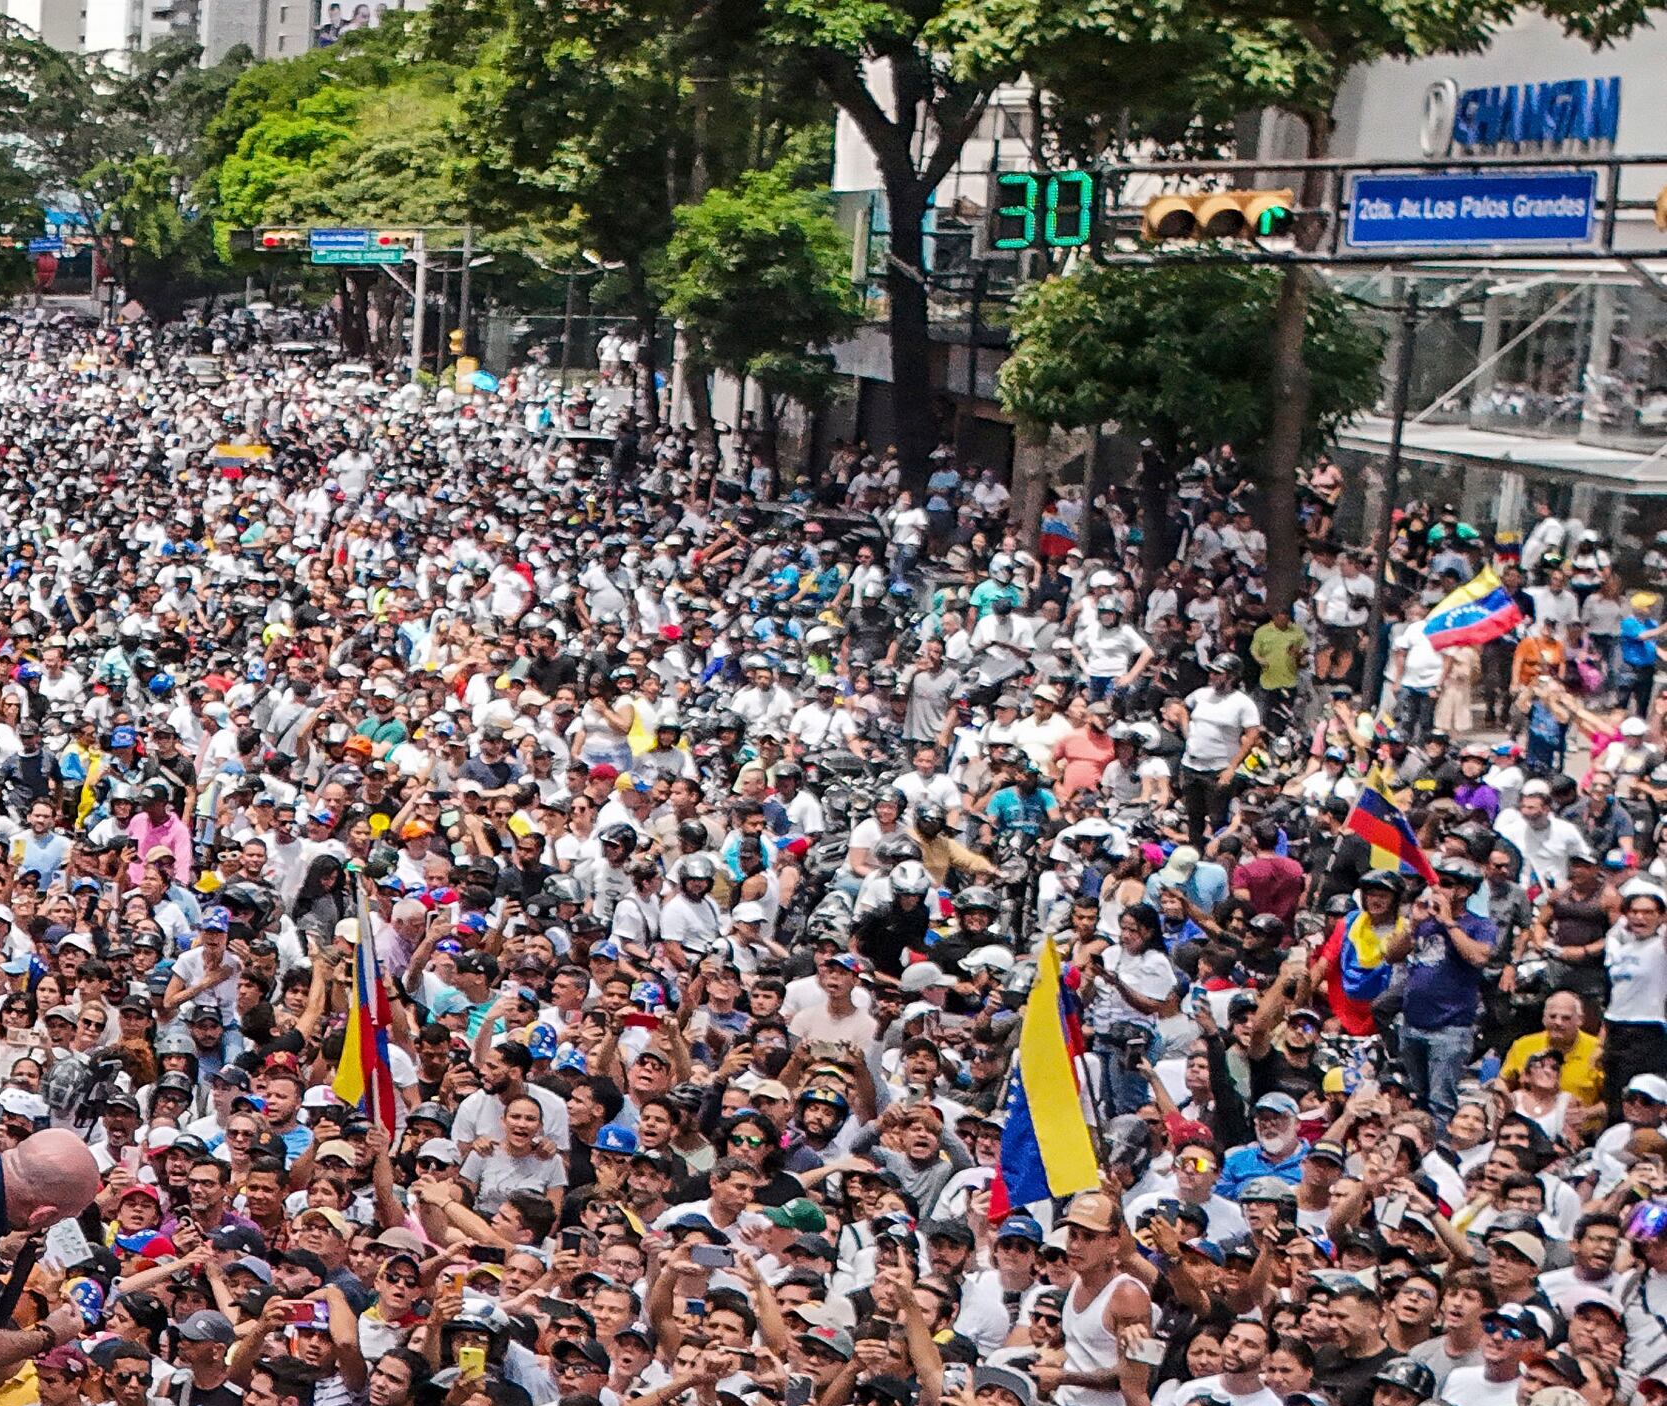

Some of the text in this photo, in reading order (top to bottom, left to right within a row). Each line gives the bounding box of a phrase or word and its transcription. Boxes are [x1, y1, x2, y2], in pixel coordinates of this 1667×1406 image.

[995, 171, 1094, 250] 30
[1423, 196, 1457, 220] Los
[1460, 195, 1510, 219] Palos
[1512, 194, 1586, 218] Grandes
